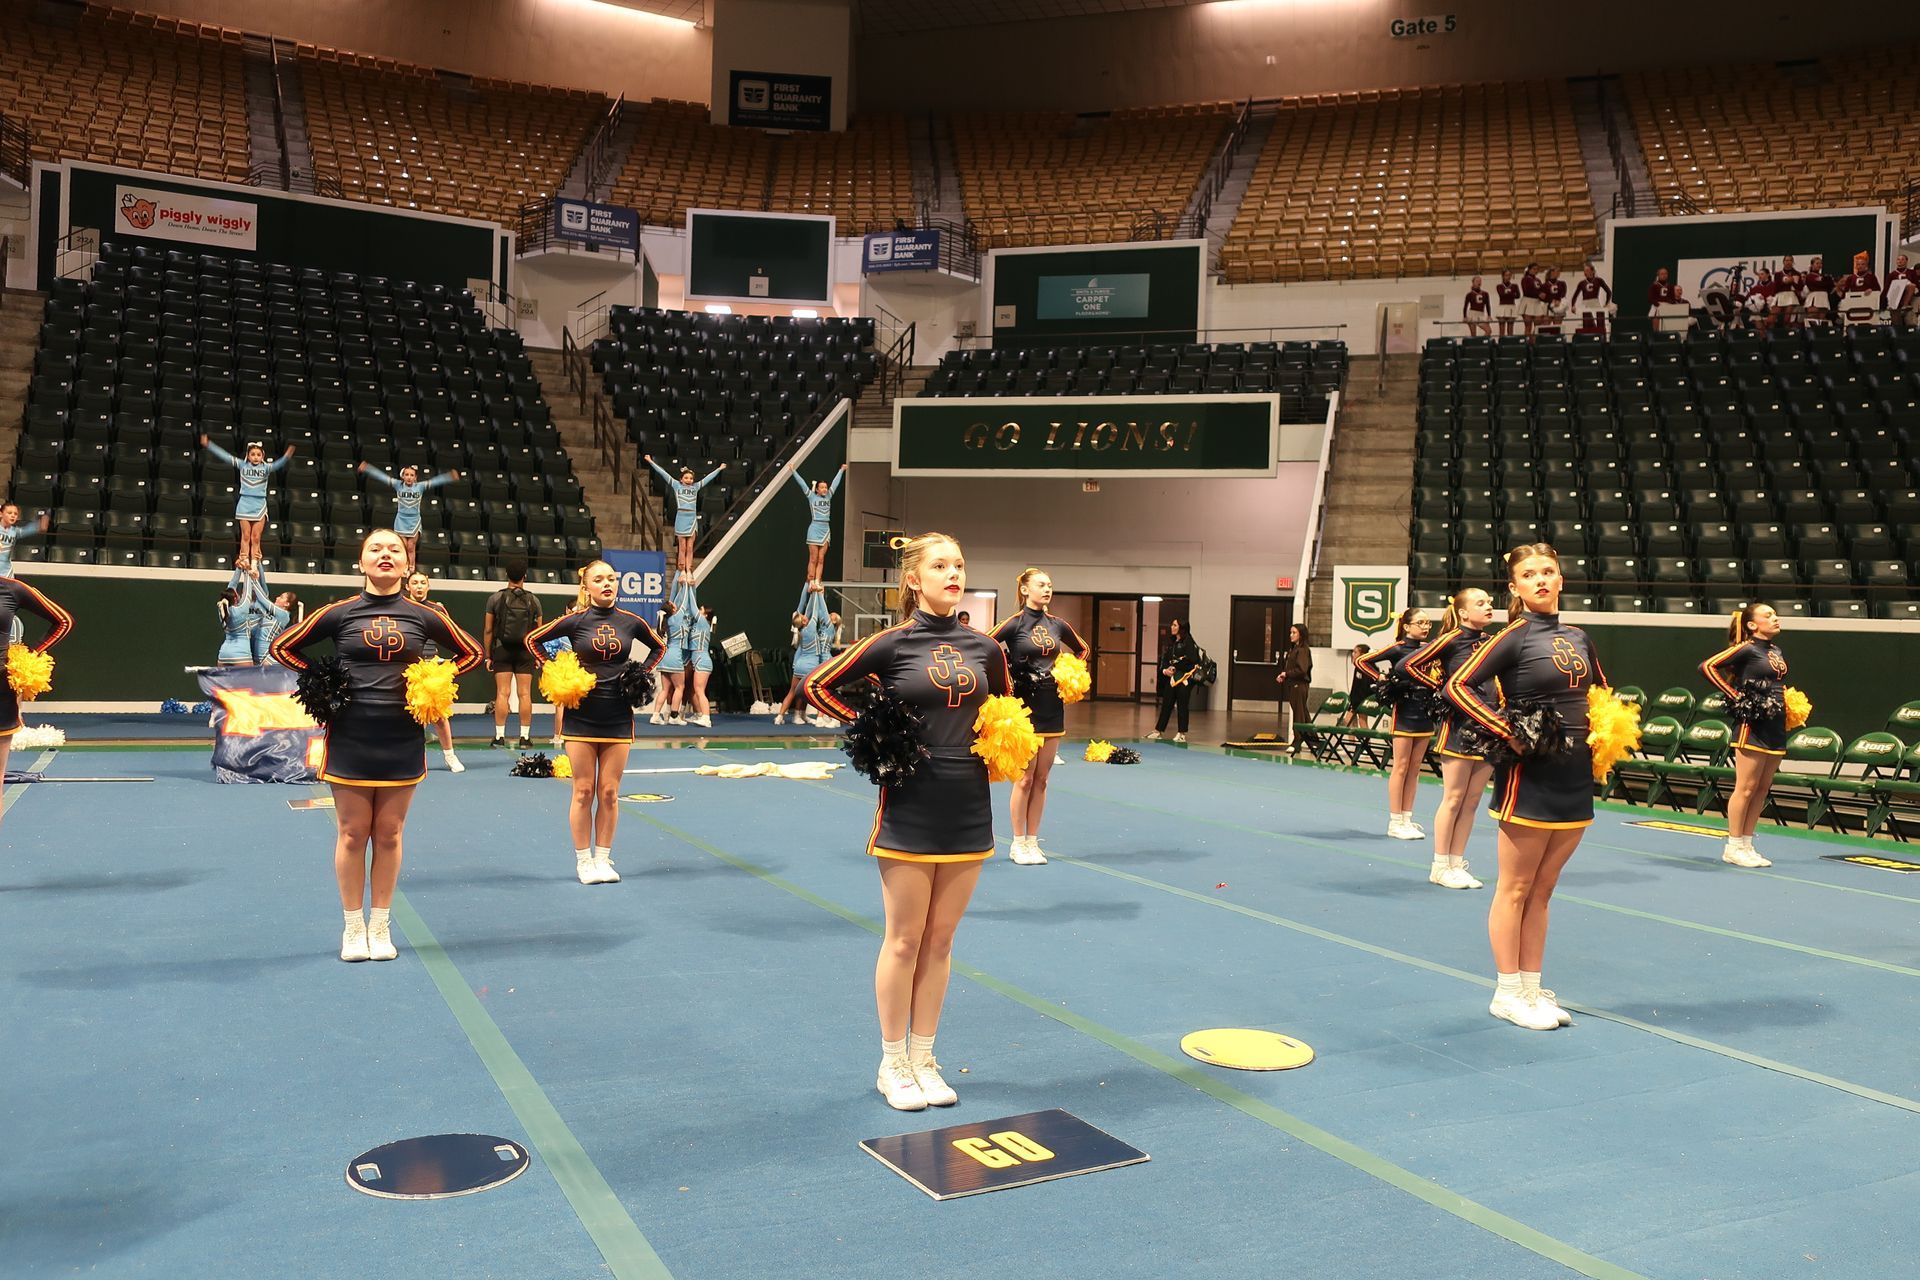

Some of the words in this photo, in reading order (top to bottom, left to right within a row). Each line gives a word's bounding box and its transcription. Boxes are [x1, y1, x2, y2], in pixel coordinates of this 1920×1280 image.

[1391, 18, 1437, 36] Gate
[1444, 14, 1457, 32] 5
[773, 83, 801, 92] FIRST
[773, 93, 822, 104] GUARANTY
[773, 102, 799, 112] BANK
[590, 209, 613, 218] FIRST
[159, 207, 202, 225] piggly
[207, 214, 251, 232] wiggly
[590, 216, 630, 229] GUARANTY
[590, 224, 611, 234] BANK
[895, 236, 916, 244] FIRST
[894, 243, 933, 251] GUARANTY
[893, 251, 914, 259] BANK
[1855, 277, 1864, 287] C
[1551, 285, 1558, 294] C
[1586, 283, 1594, 292] C
[1660, 287, 1668, 297] C
[1075, 295, 1110, 303] CARPET
[1475, 294, 1483, 303] C
[1083, 303, 1102, 311] ONE
[964, 422, 1021, 450] GO
[1042, 421, 1198, 451] LIONS!
[242, 468, 266, 478] LIONS
[1085, 481, 1099, 491] EXIT
[398, 490, 421, 499] LIONS
[1356, 589, 1384, 620] S
[1659, 694, 1687, 704] Lions
[1643, 722, 1674, 735] Lions
[1690, 725, 1724, 739] Lions
[1794, 733, 1833, 749] Lions
[1855, 739, 1896, 755] Lions
[952, 1130, 1055, 1169] GO
